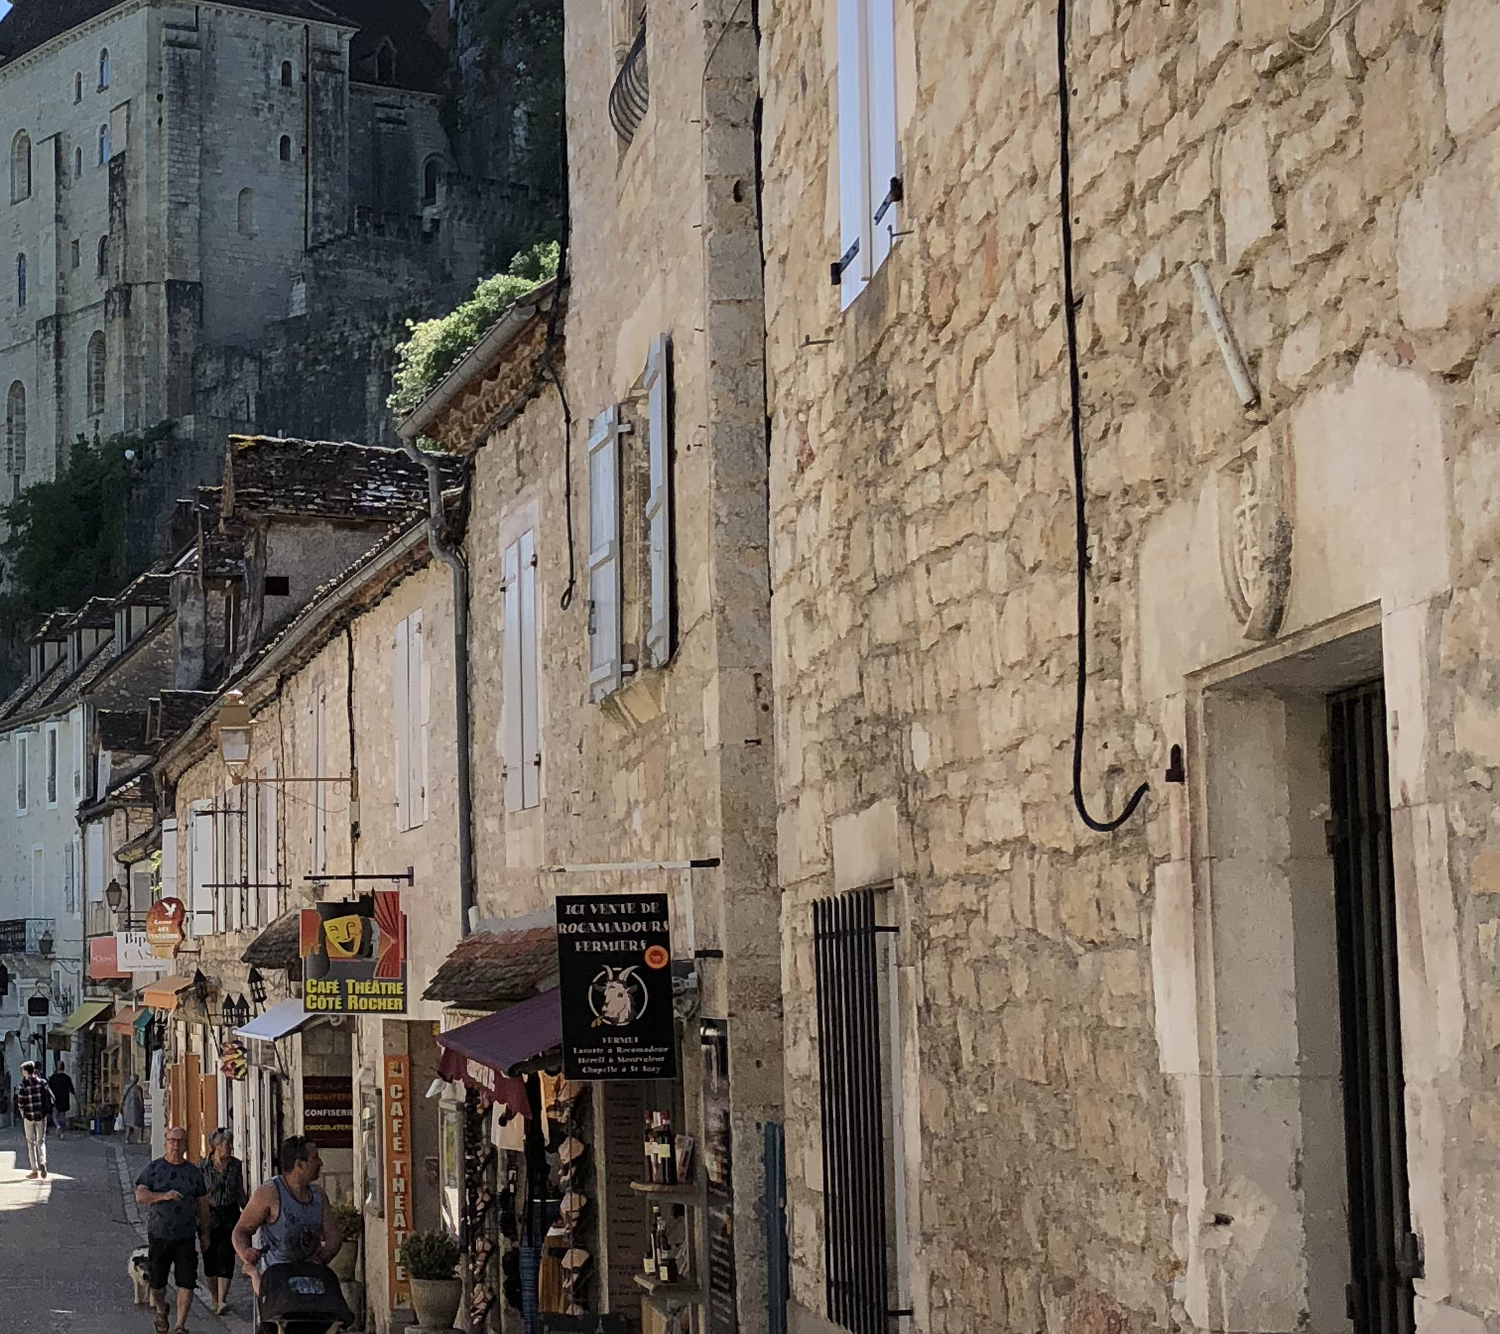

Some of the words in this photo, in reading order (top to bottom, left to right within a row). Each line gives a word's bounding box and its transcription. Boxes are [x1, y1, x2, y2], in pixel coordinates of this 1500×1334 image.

[564, 903, 585, 915] ICI
[590, 902, 636, 915] VENTE
[641, 902, 660, 914] DE
[558, 920, 669, 934] ROCAMADOURS
[574, 939, 647, 952] FERMIERS
[306, 978, 340, 994] CAFÉ
[345, 978, 404, 995] THÉÂTRE
[306, 994, 343, 1010] CÔTÉ
[347, 994, 403, 1011] ROCHER
